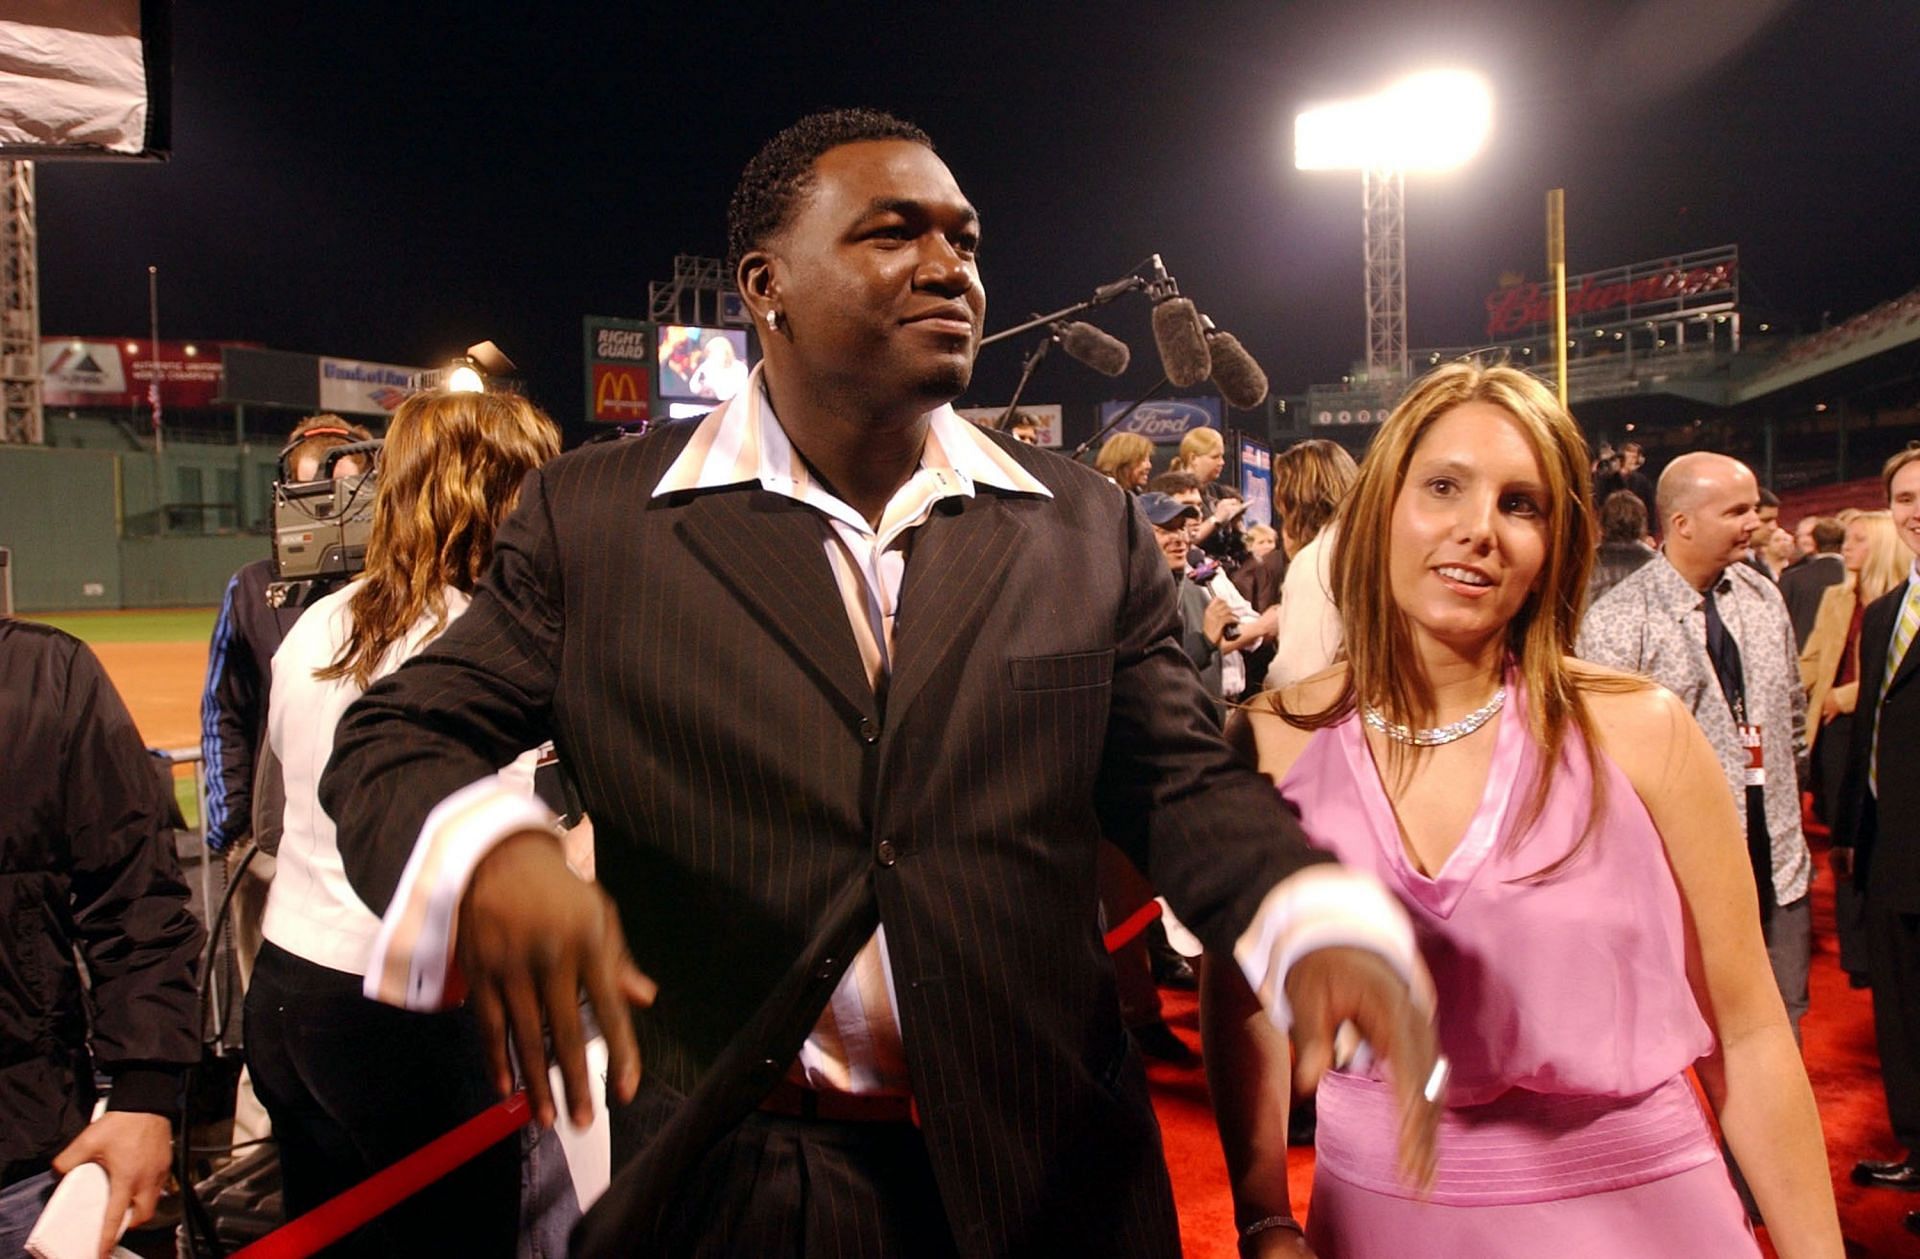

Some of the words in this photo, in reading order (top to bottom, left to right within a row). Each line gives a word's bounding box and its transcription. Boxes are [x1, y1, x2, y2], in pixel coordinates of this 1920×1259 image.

[598, 329, 644, 344] RIGHT
[597, 342, 644, 359] GUARD
[1127, 407, 1190, 433] Ford
